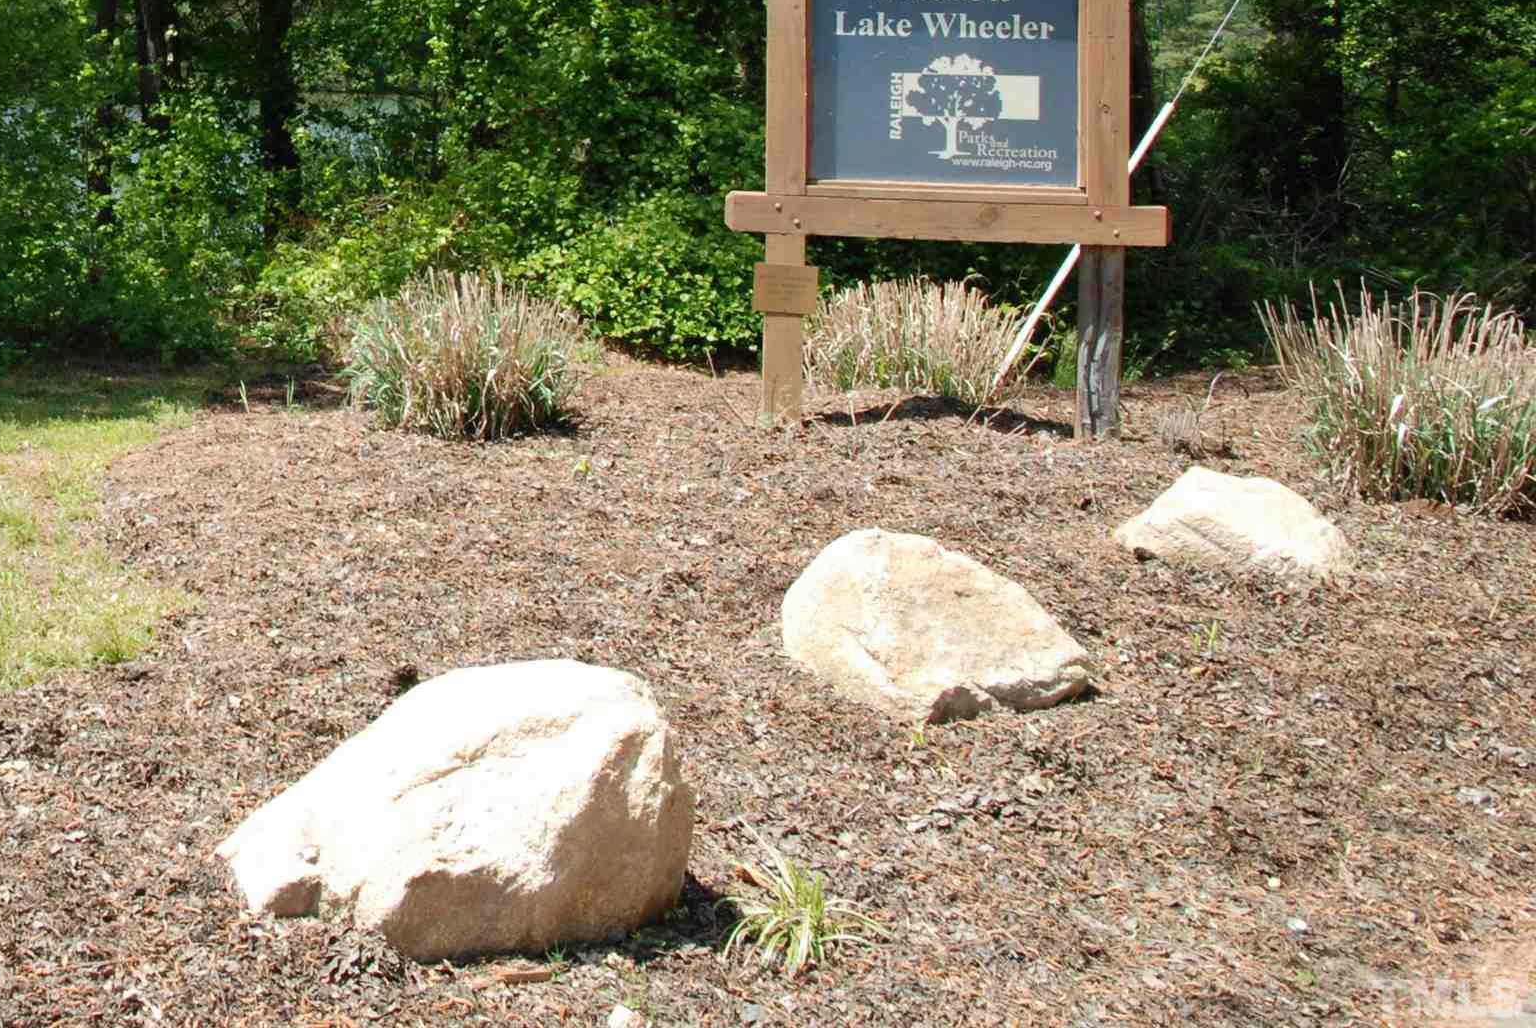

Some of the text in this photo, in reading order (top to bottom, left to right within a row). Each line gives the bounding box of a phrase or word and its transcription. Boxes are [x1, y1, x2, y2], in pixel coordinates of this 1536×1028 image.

[834, 11, 1055, 40] Lake Wheeler
[889, 72, 905, 140] RALEIGH
[959, 130, 995, 145] Parks
[976, 143, 1058, 159] Recreation
[952, 157, 1052, 172] www.raleigh-nc.org
